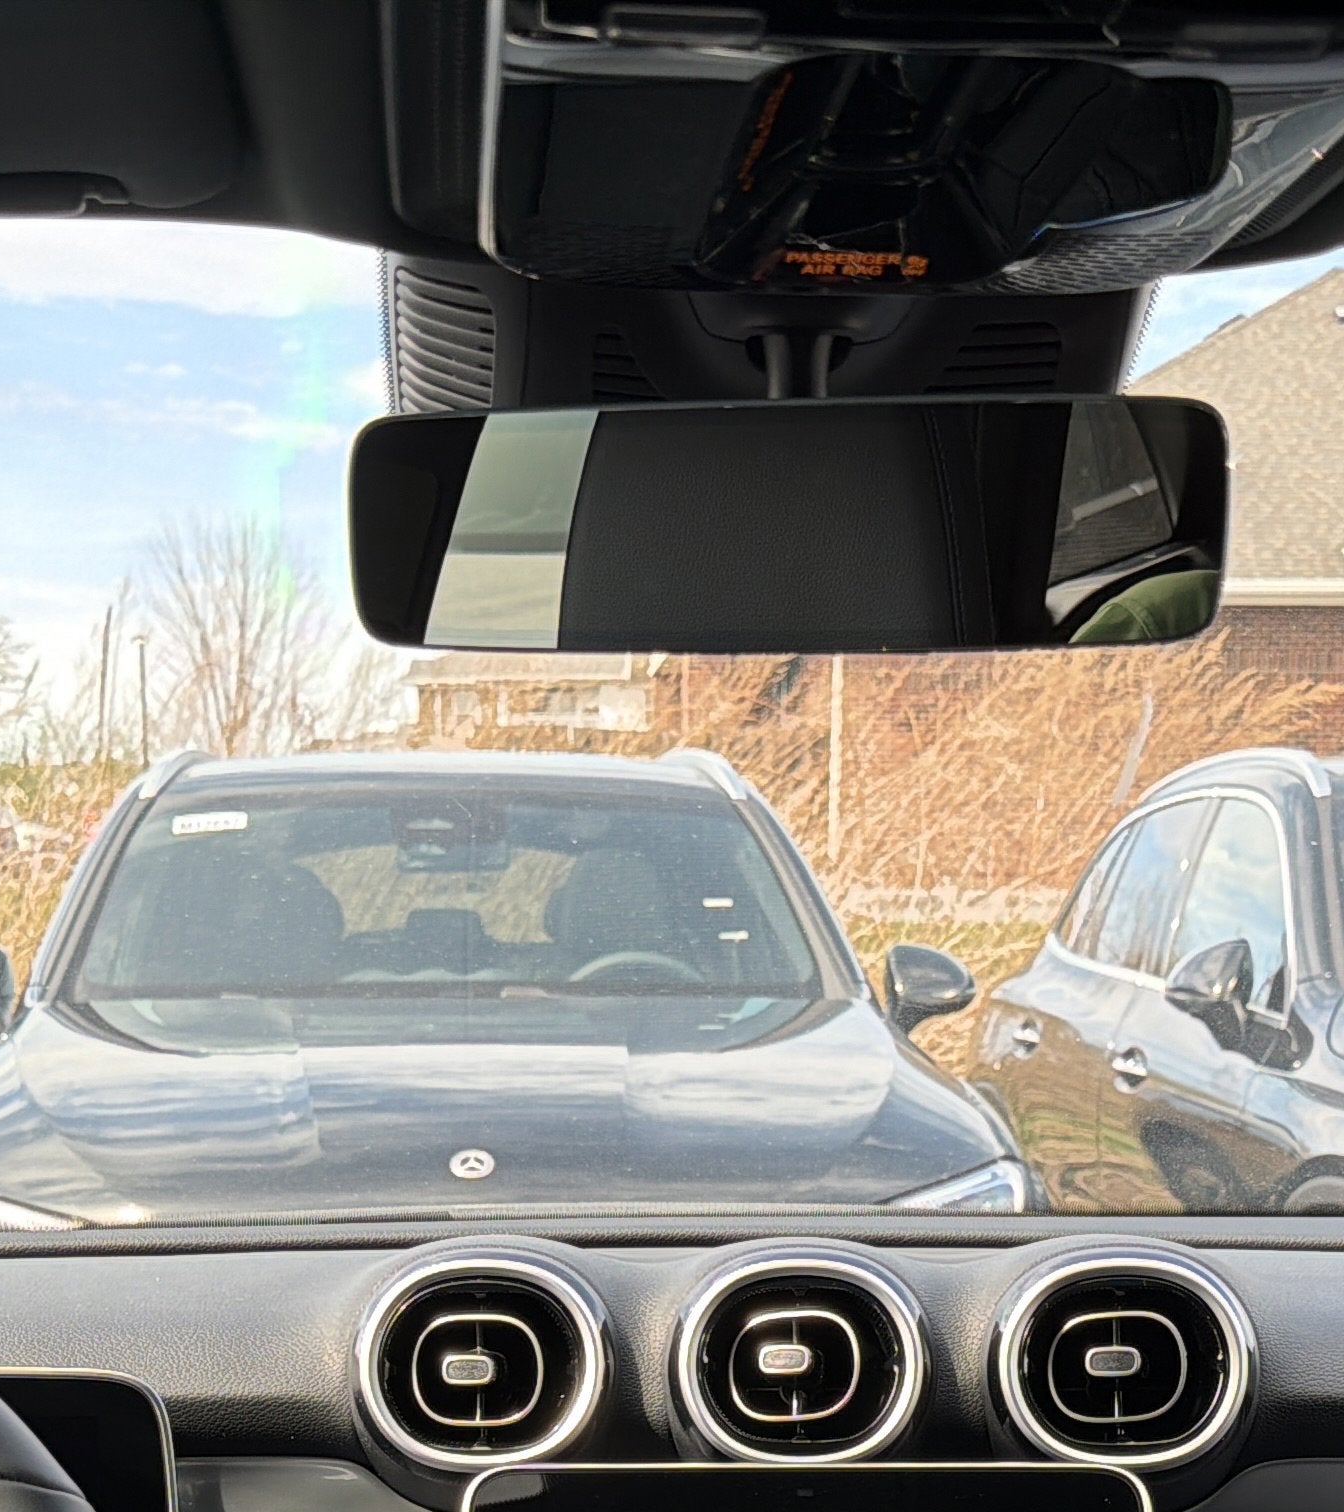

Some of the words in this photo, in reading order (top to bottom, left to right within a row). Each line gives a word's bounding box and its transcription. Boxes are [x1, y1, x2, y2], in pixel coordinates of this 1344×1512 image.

[785, 252, 902, 265] PASSENGER
[800, 264, 835, 275] AIR
[841, 264, 883, 276] BAG
